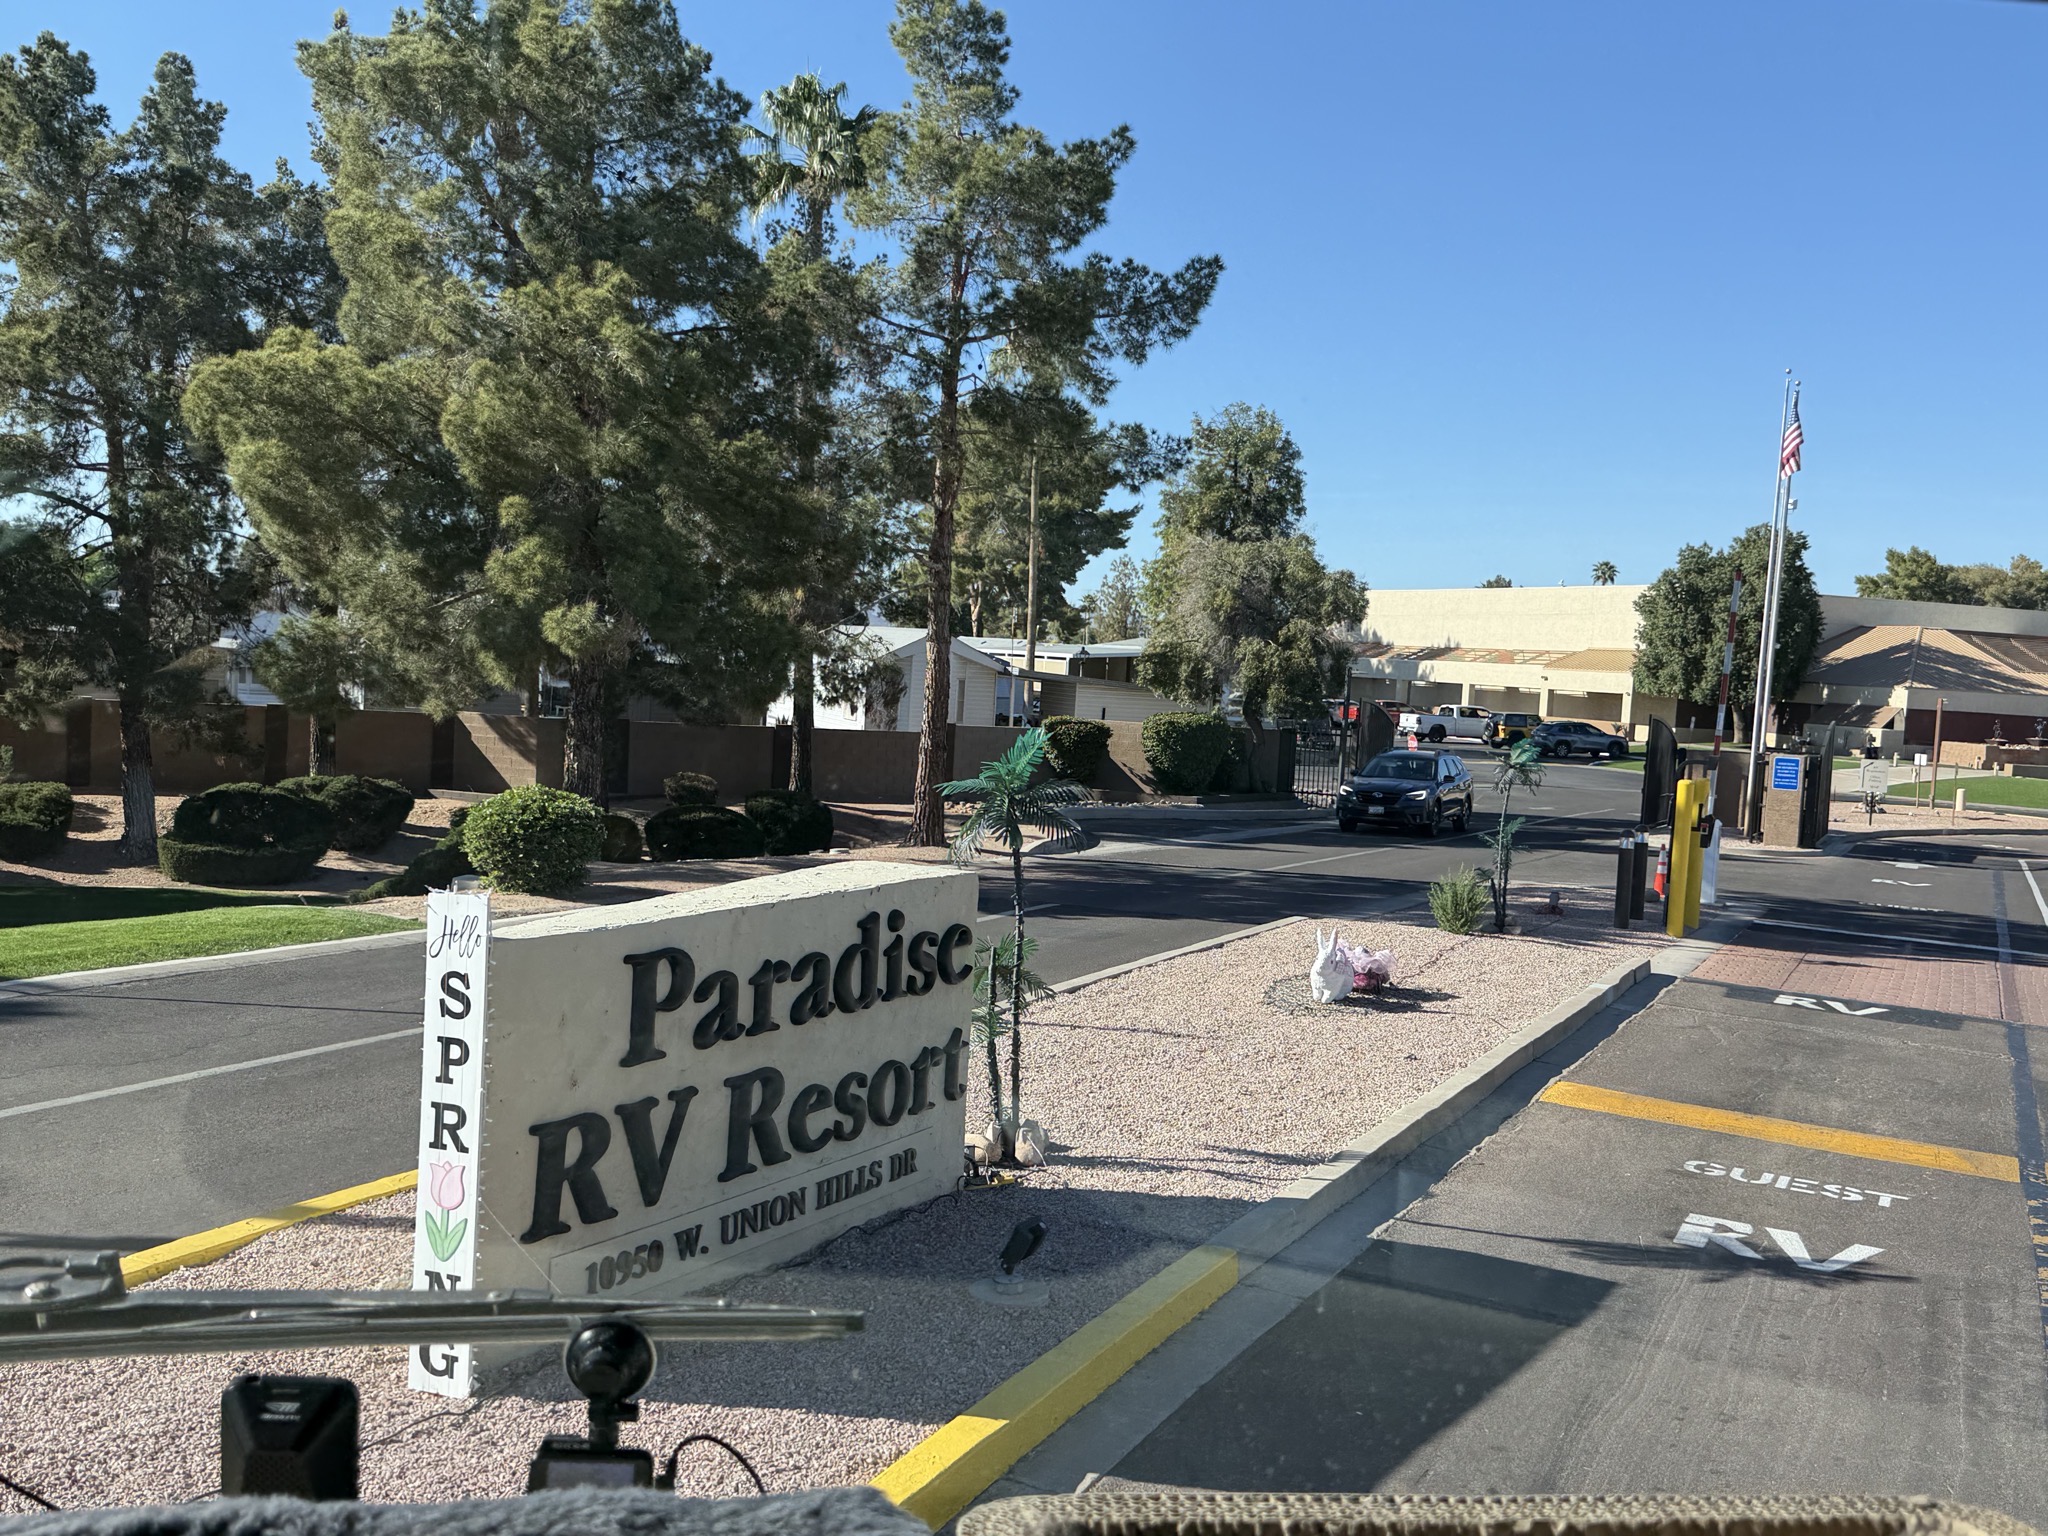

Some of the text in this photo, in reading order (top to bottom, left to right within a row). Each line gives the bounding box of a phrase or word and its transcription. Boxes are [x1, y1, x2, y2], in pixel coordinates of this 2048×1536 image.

[429, 914, 482, 959] Hello
[619, 908, 974, 1068] Paradise
[1773, 994, 1891, 1016] RV
[520, 1027, 969, 1244] RV Resort
[1683, 1160, 1912, 1208] GUEST
[585, 1147, 919, 1294] 10950 W. UNION HILLS DR
[1673, 1213, 1888, 1273] RV
